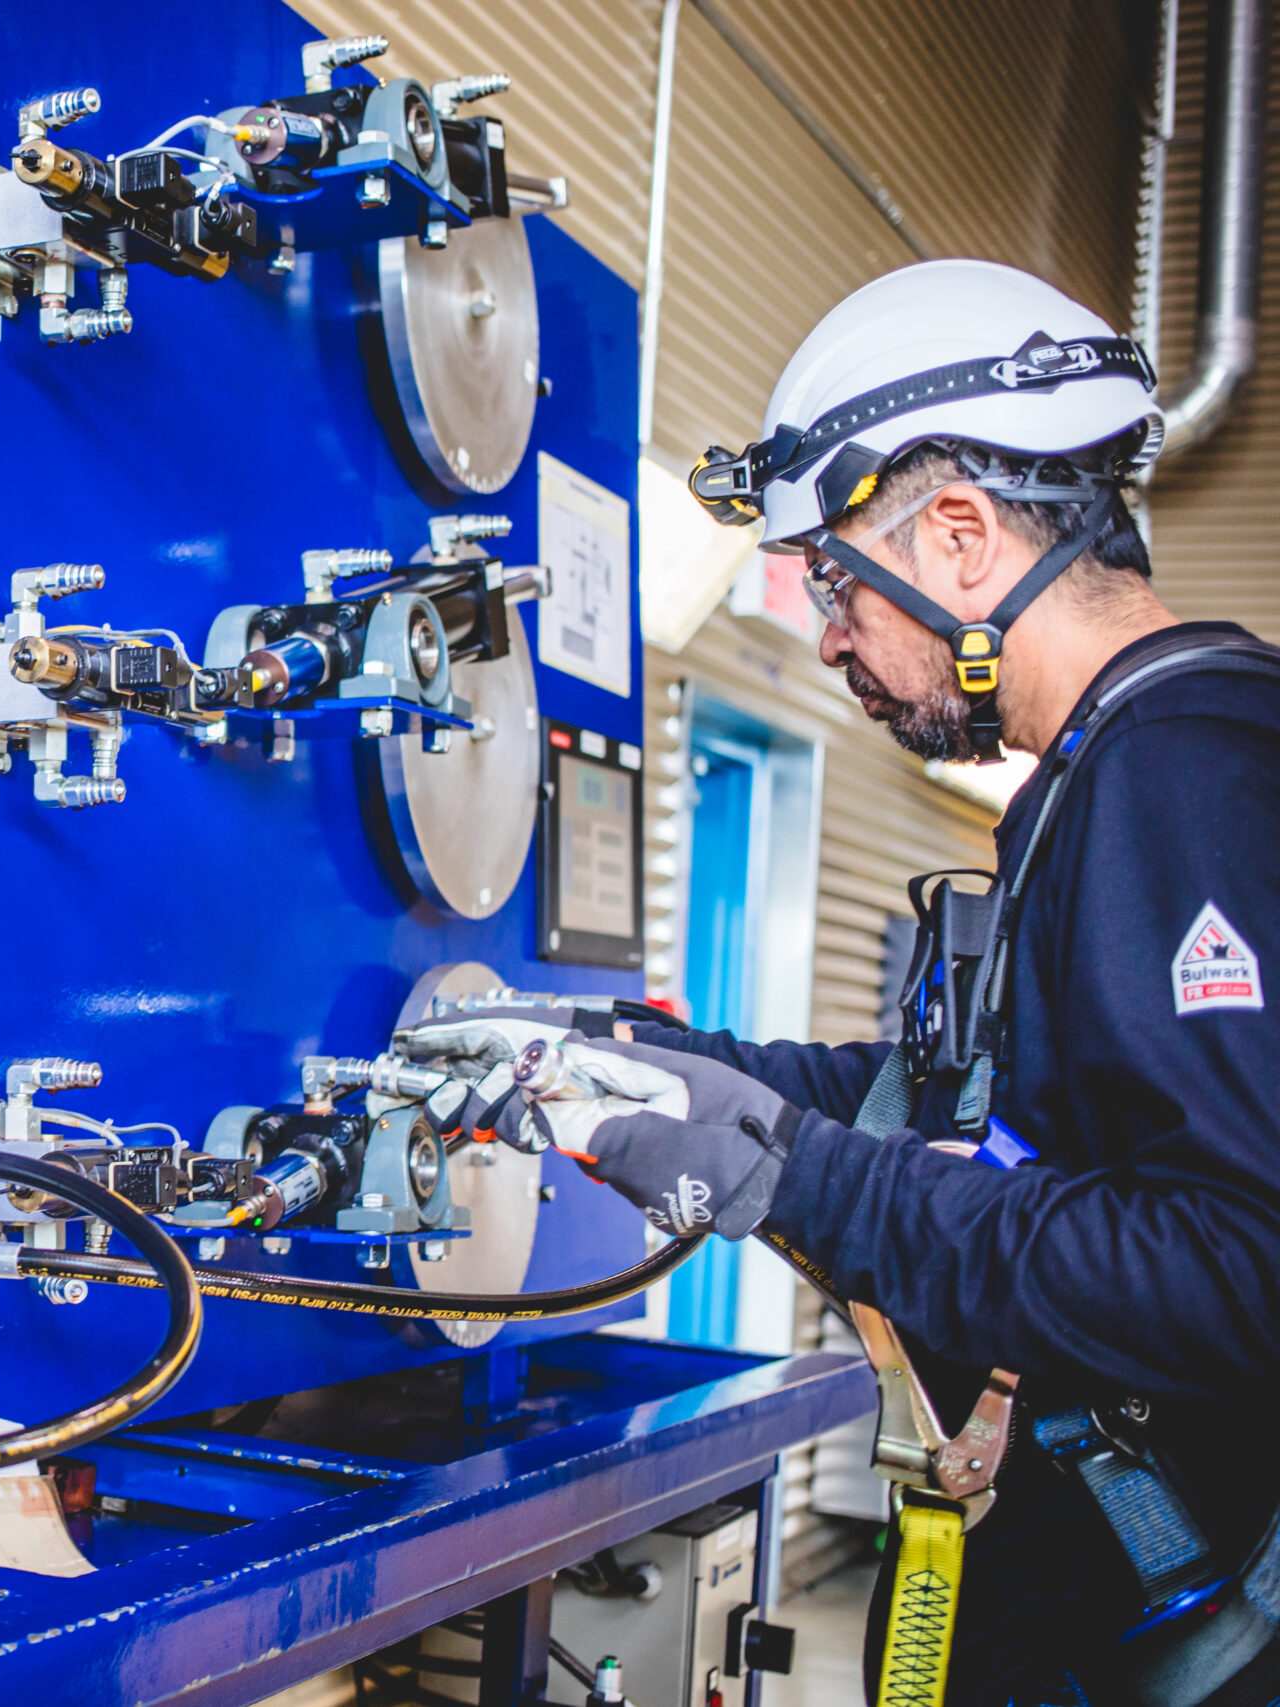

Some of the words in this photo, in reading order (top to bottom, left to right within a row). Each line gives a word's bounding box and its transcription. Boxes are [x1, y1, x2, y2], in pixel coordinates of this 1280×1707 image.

[1180, 966, 1250, 983] Bulwark
[231, 1287, 261, 1301] PSI)
[261, 1293, 298, 1306] (3000
[299, 1297, 327, 1310] MPa
[353, 1304, 375, 1314] WP
